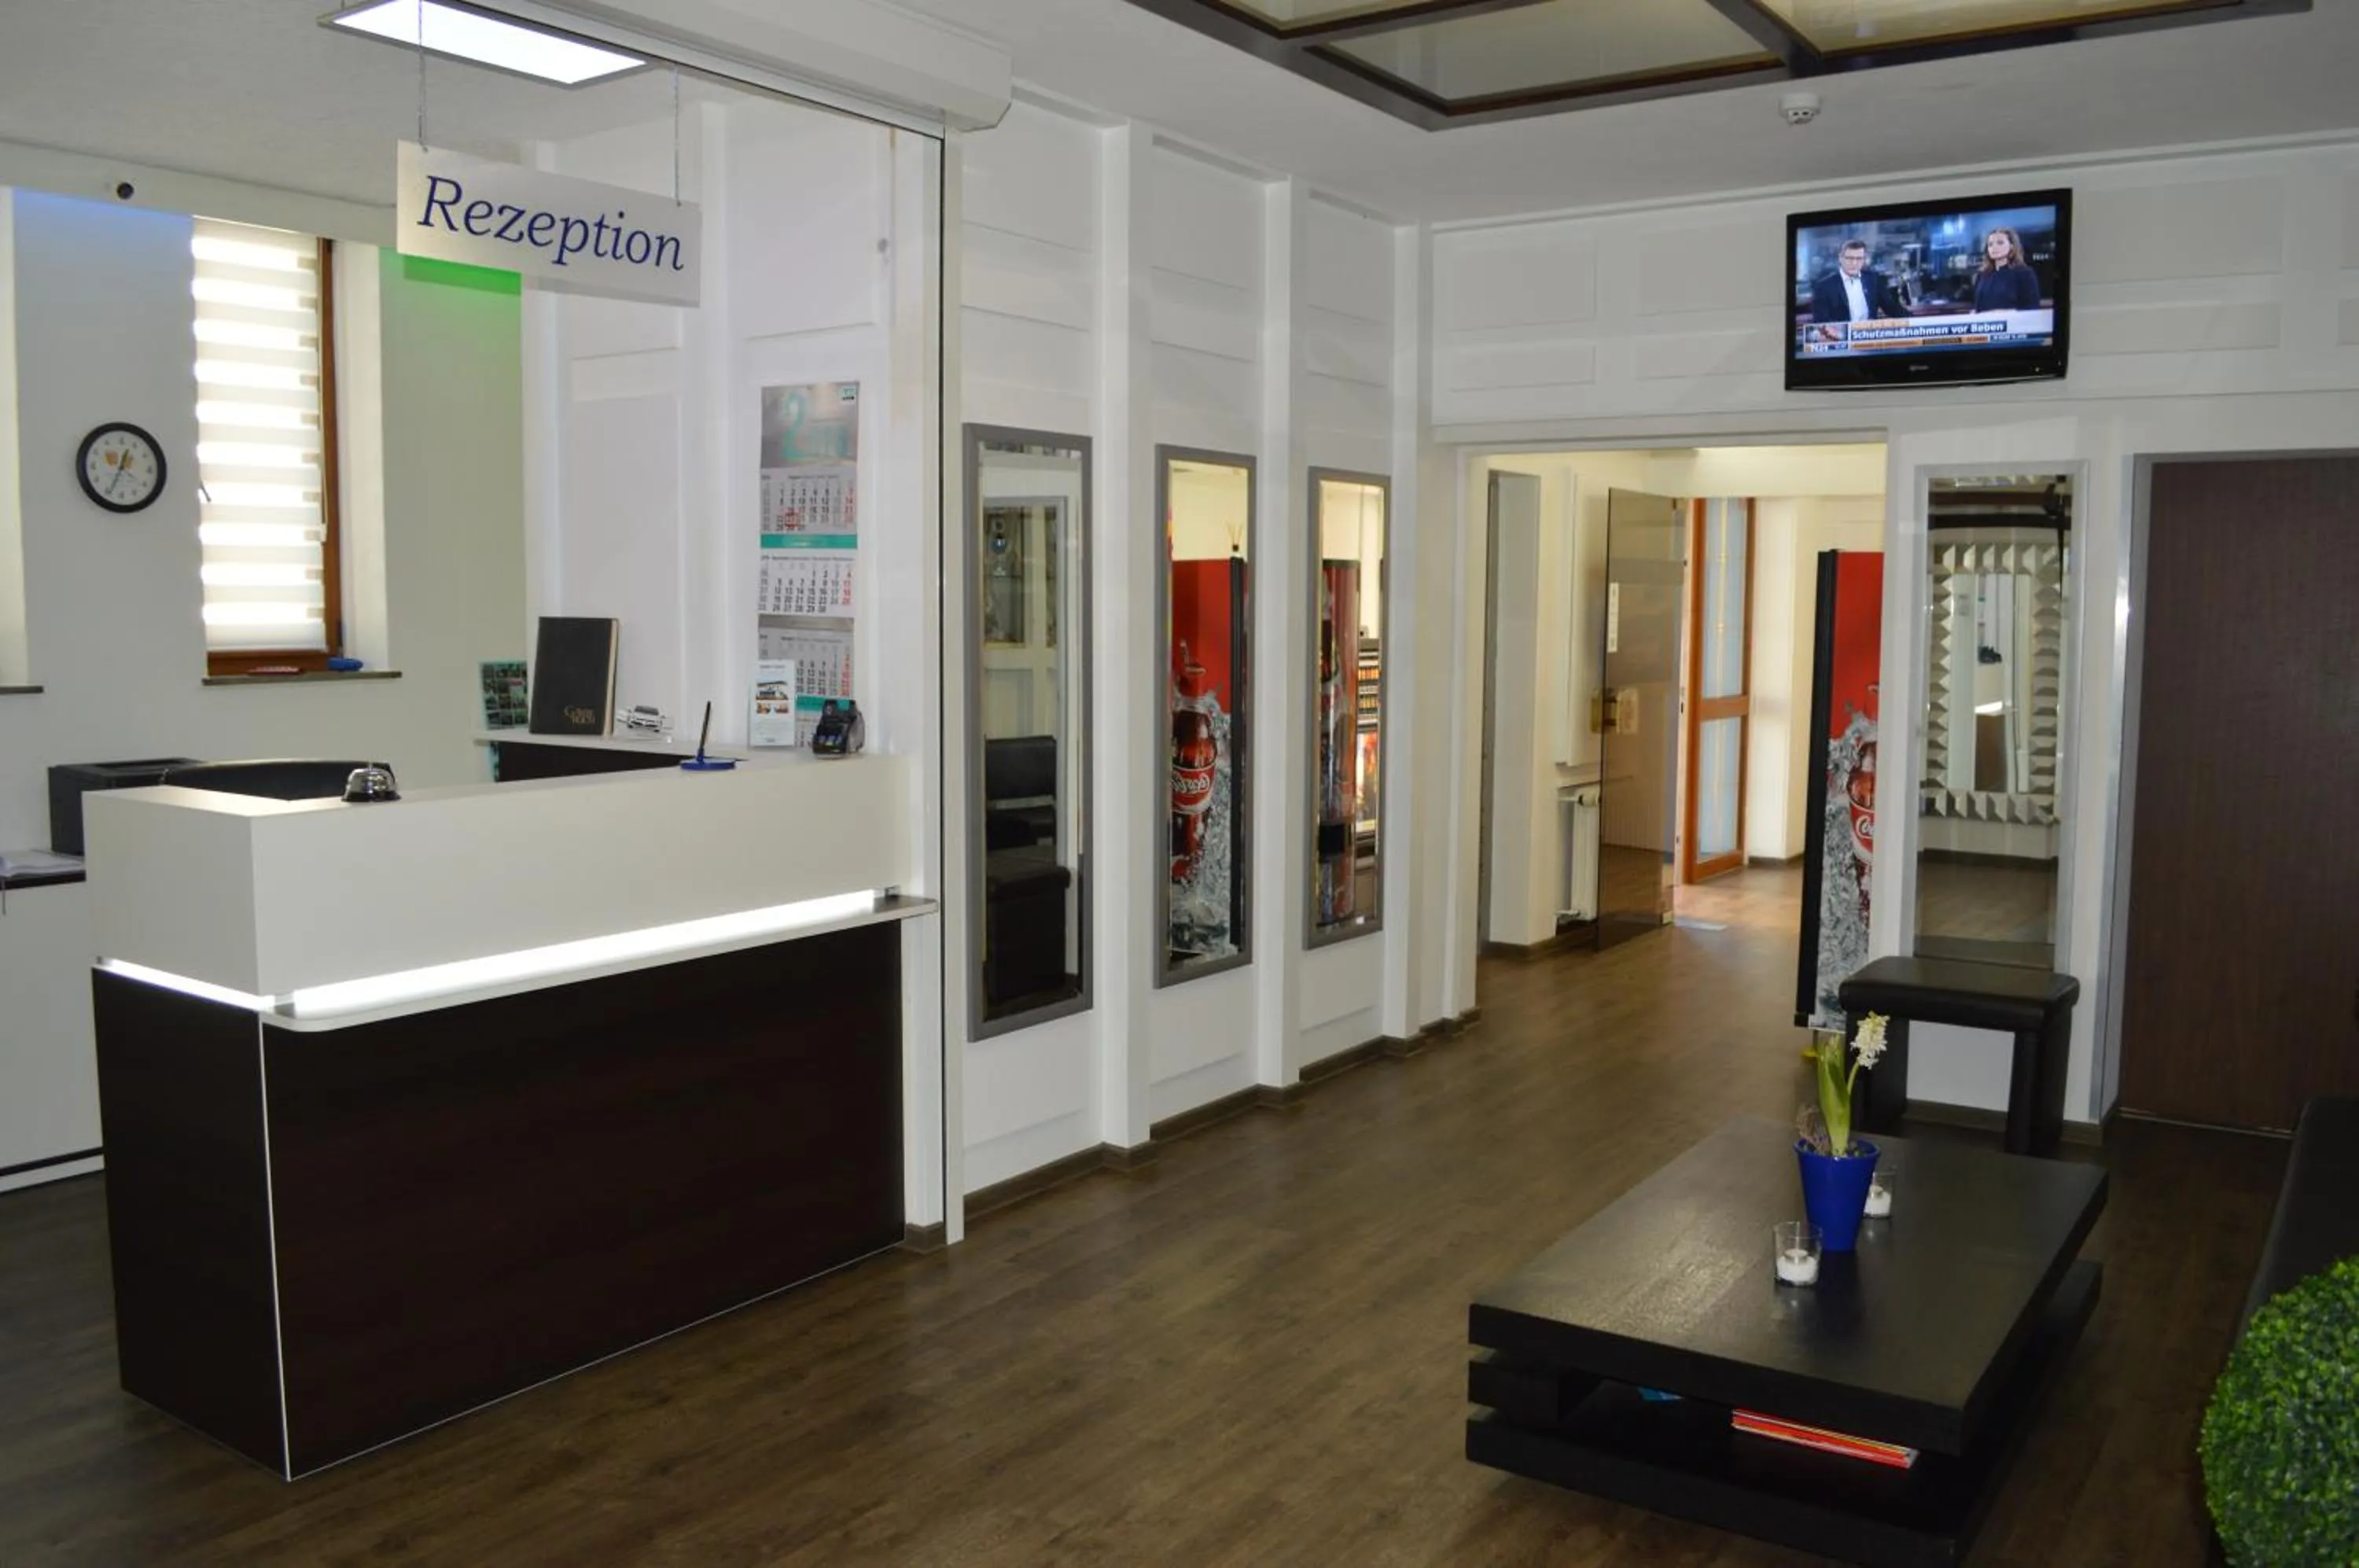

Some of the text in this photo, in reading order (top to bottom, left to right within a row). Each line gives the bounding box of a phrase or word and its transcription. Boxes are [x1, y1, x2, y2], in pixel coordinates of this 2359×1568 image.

[417, 175, 684, 271] Rezeption
[1852, 322, 2004, 339] Schutzmaßnahmen vor Beben
